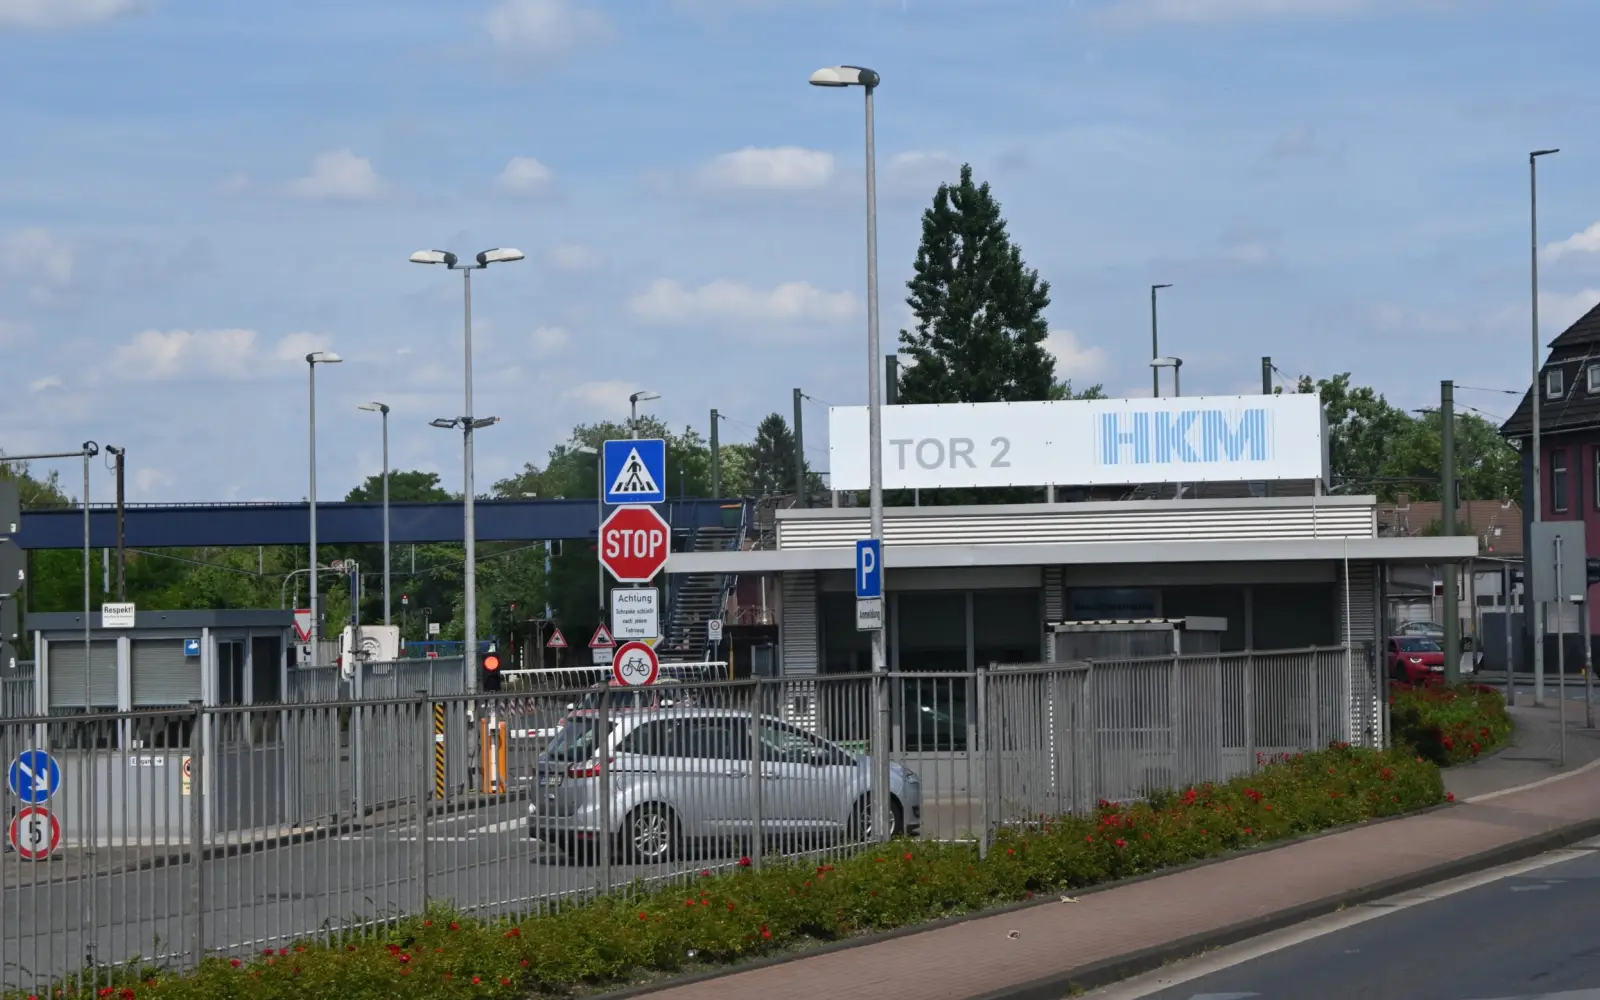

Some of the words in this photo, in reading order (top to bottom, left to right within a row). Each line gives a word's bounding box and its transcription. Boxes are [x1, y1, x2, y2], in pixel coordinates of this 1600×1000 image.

[1102, 408, 1269, 465] HKM
[890, 437, 975, 470] TOR
[990, 436, 1011, 467] 2
[607, 530, 662, 558] STOP
[862, 546, 875, 590] P
[104, 605, 133, 615] Respekt!
[618, 593, 652, 604] Achtung
[29, 821, 42, 844] 5
